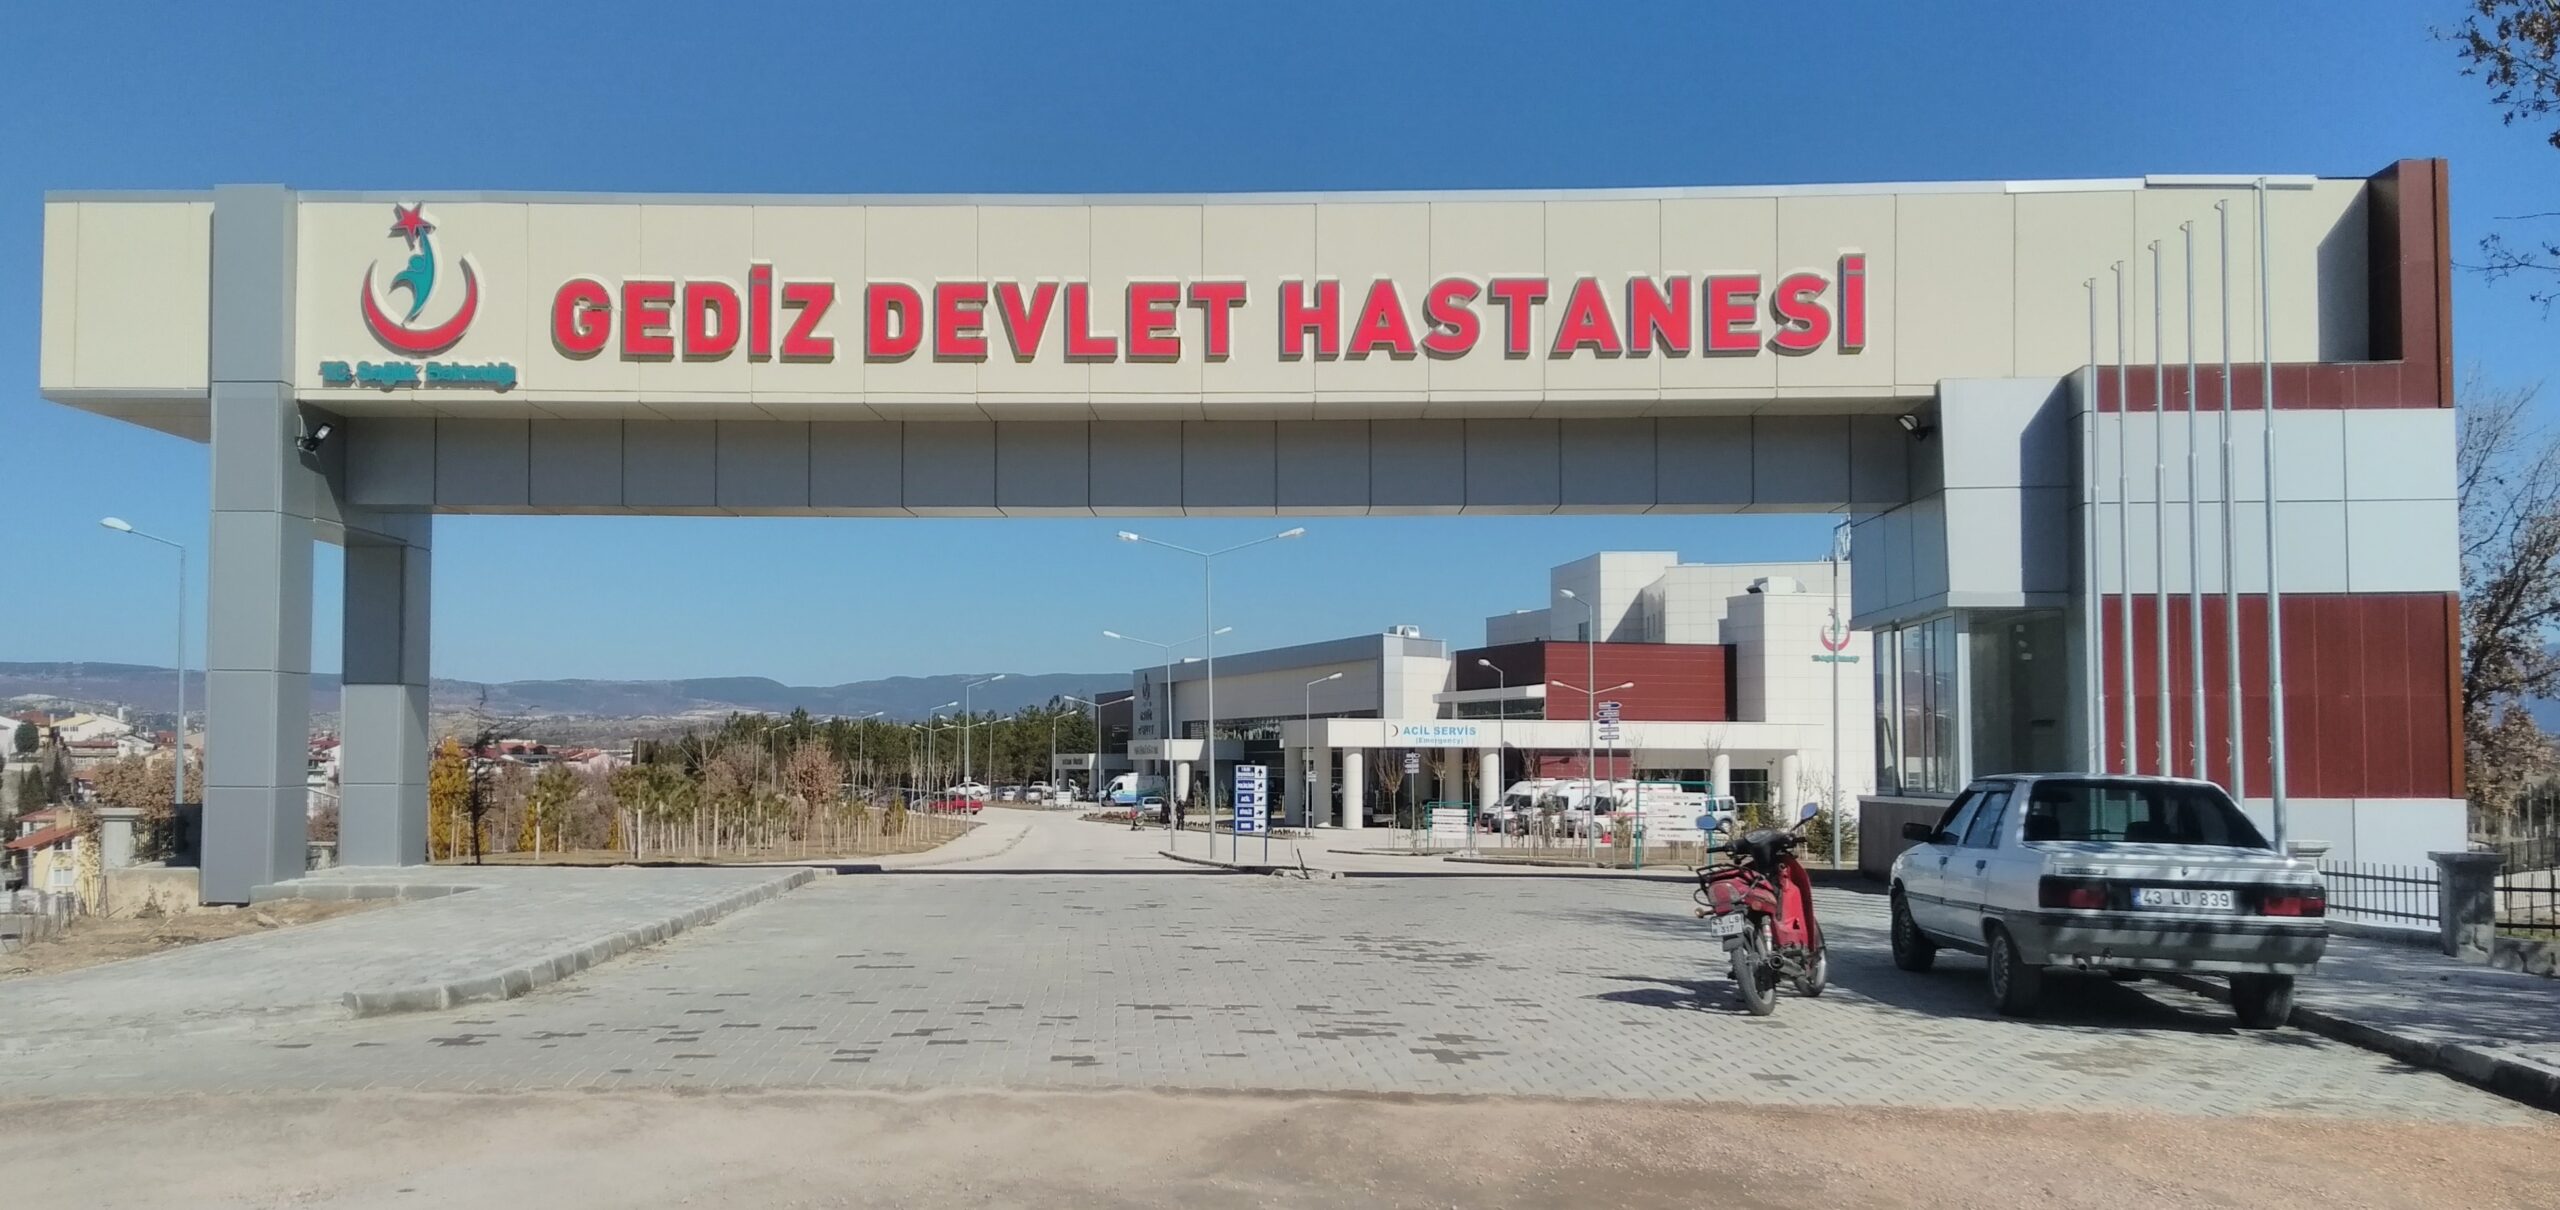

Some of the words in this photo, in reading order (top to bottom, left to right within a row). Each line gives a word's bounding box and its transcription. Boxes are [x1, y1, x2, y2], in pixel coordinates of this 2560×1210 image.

[551, 263, 835, 362] GEDİZ
[864, 281, 1247, 363] DEVLET
[1278, 253, 1866, 361] HASTANESİ
[1403, 725, 1430, 736] ACİL
[1433, 725, 1476, 736] SERVİS
[2143, 889, 2163, 905] 43
[2171, 890, 2190, 906] LU
[2200, 891, 2230, 907] 839
